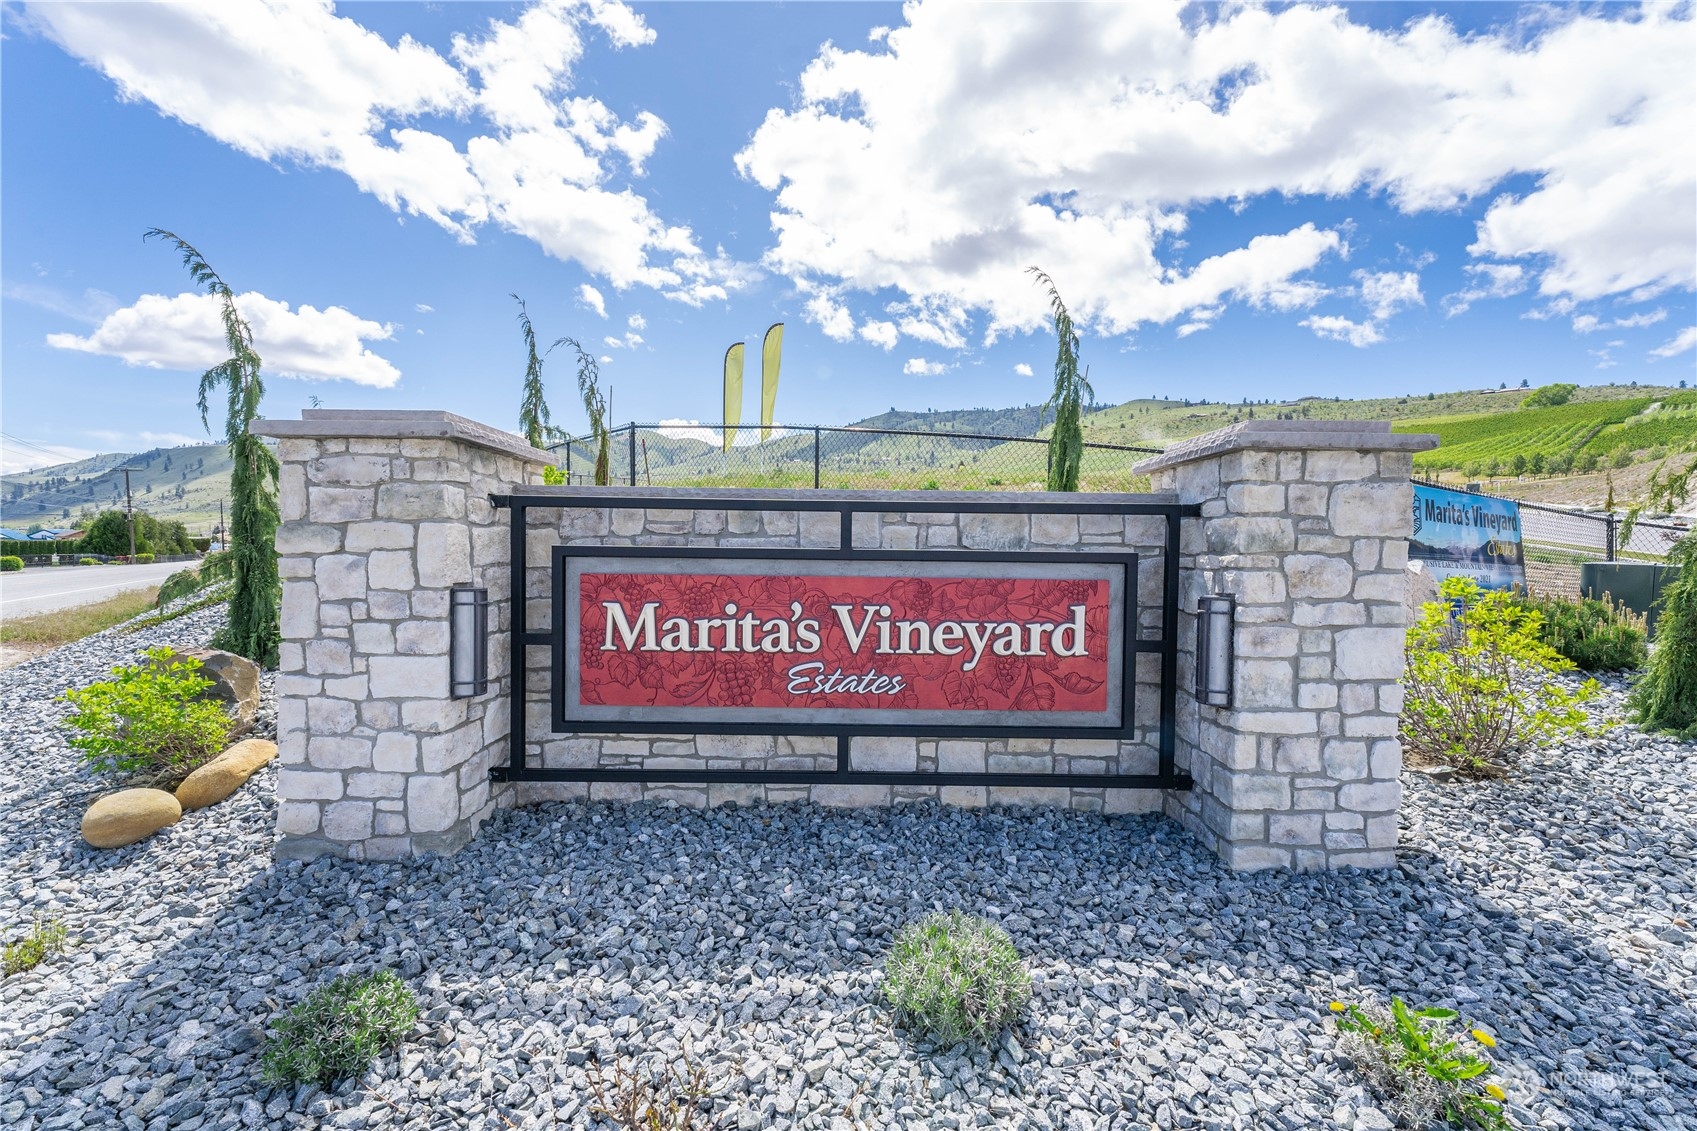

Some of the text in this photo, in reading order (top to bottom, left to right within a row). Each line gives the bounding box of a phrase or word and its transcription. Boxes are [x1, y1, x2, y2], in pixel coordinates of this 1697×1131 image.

[1425, 498, 1518, 535] Marita's Vineyard
[1480, 574, 1491, 583] 2021
[600, 601, 1089, 672] Marita's Vineyard
[786, 661, 907, 696] Estates
